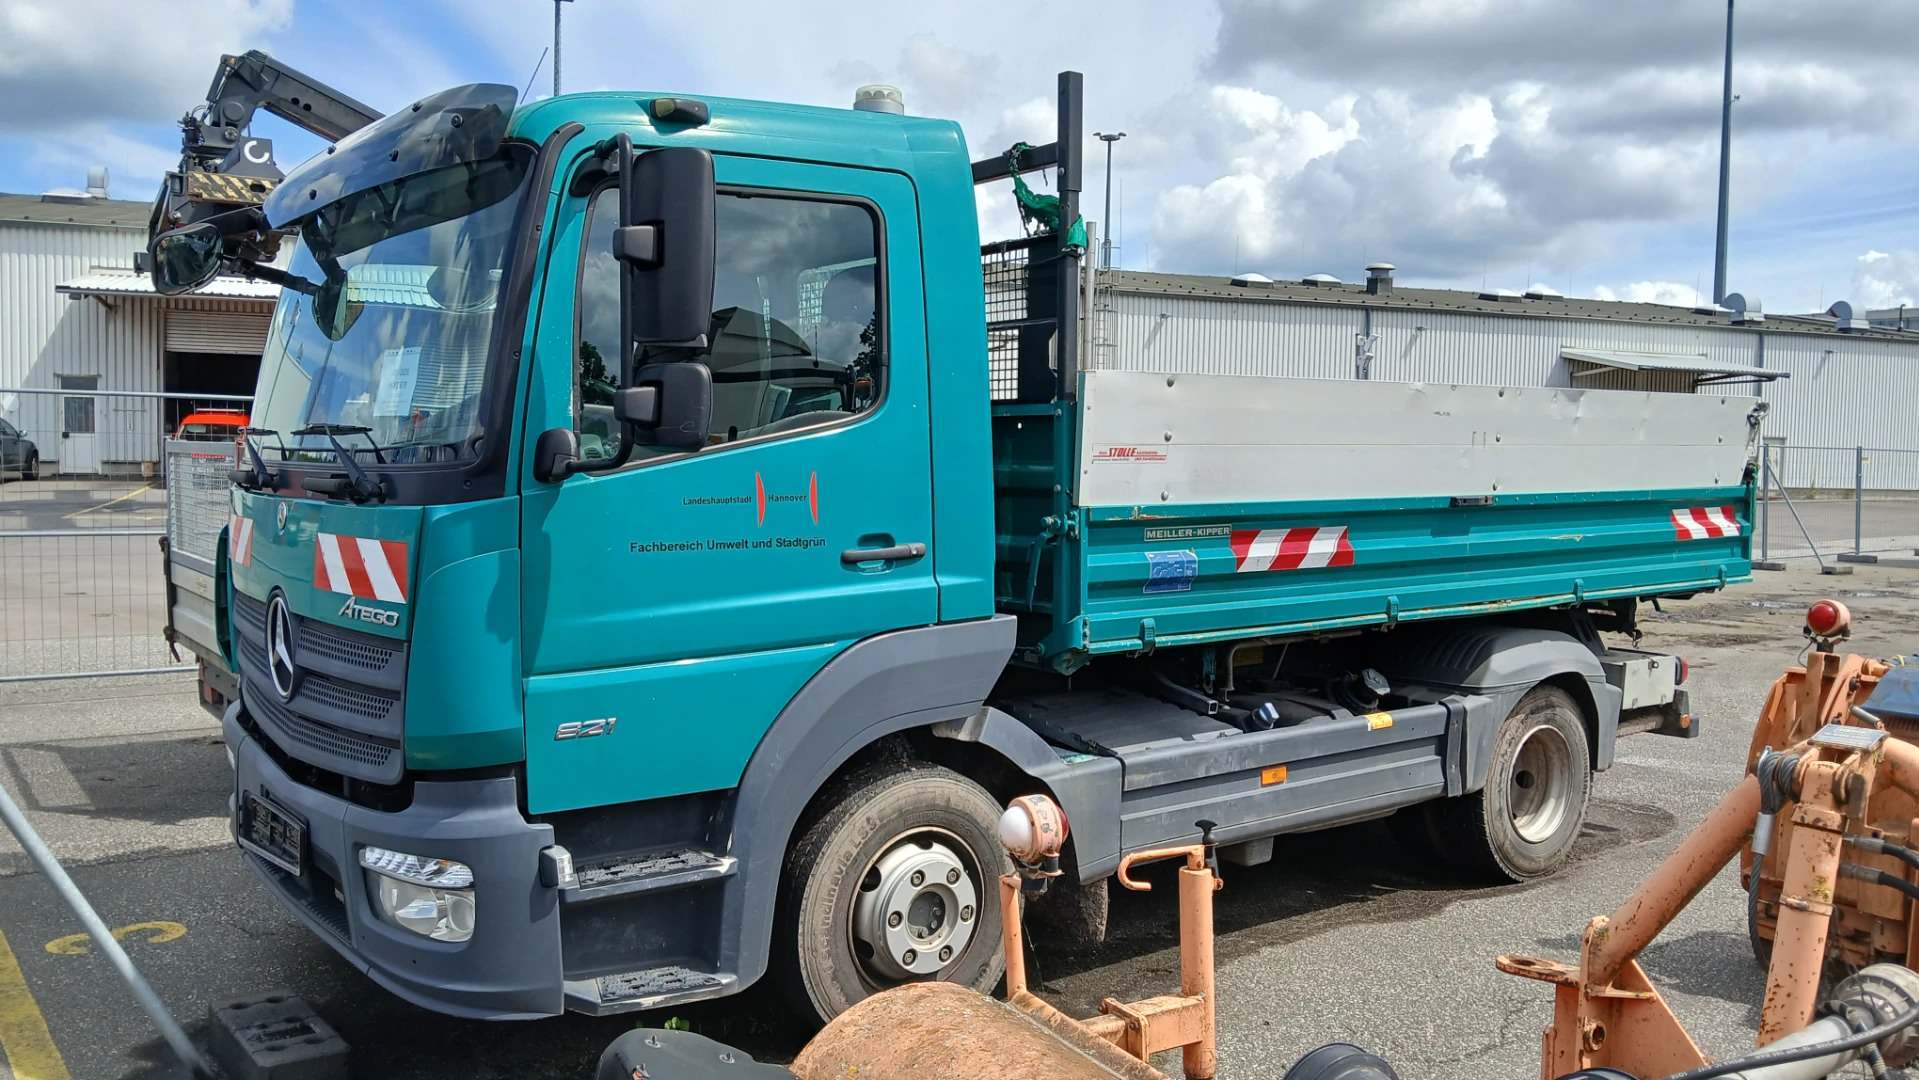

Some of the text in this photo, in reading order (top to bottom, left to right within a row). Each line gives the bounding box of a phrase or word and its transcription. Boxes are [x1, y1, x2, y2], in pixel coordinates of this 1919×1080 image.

[1109, 447, 1138, 457] STOLLE
[683, 493, 807, 506] Landeshauptstadt Hannover
[1146, 526, 1230, 539] MEILLER-KIPPER
[629, 536, 826, 553] Fachbereich Umwelt und Stadtgrün
[554, 717, 617, 741] 821
